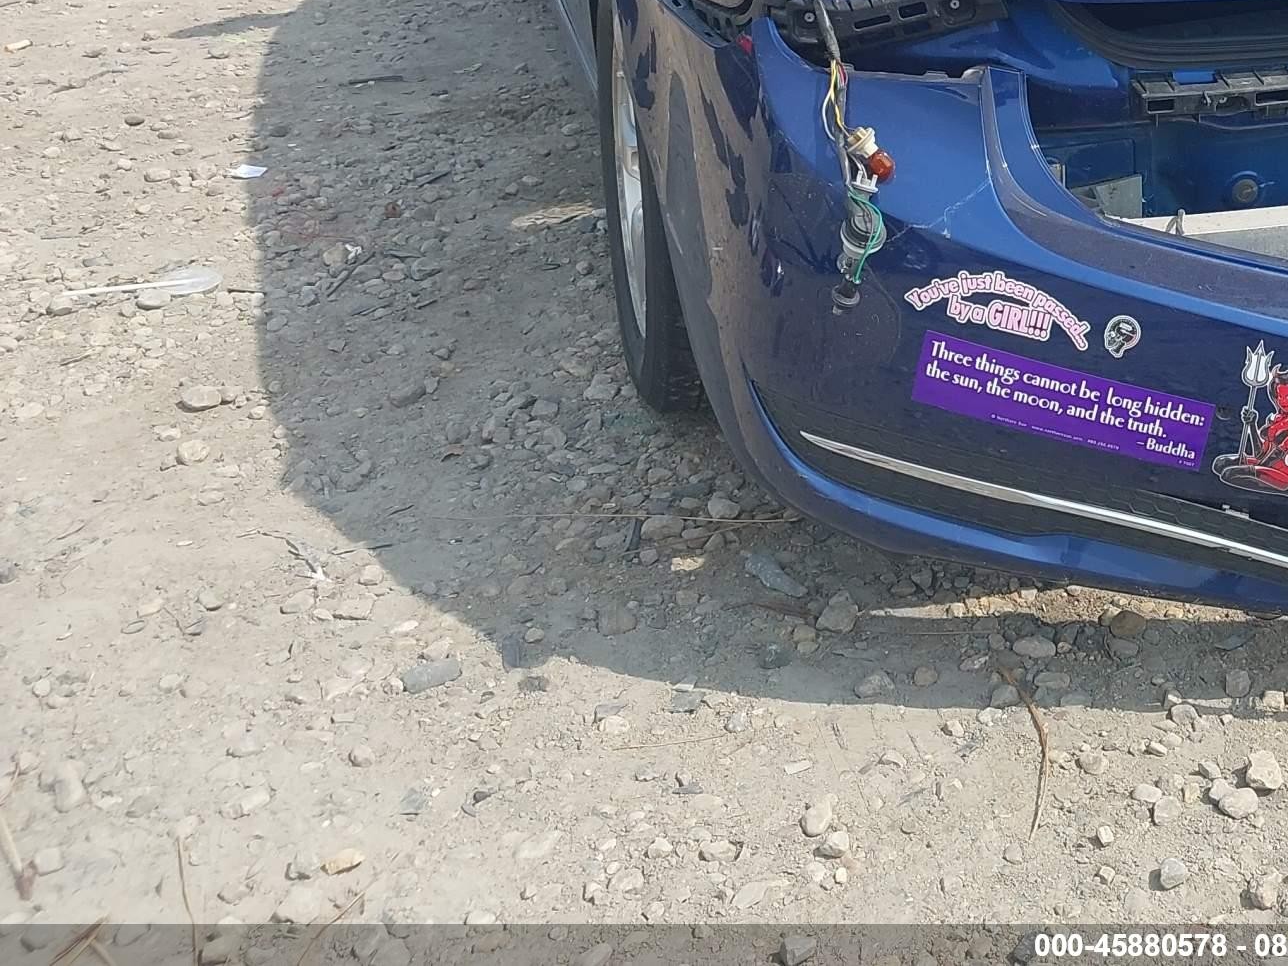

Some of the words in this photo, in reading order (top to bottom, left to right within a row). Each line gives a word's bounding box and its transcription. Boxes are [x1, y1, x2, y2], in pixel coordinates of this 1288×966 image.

[906, 278, 959, 310] You've
[960, 272, 993, 293] just
[995, 272, 1034, 302] been
[949, 297, 973, 323] by
[973, 307, 985, 322] a
[988, 301, 1050, 340] GIRL!!!
[926, 362, 950, 382] the
[952, 375, 982, 395] sun,
[986, 379, 1011, 399] the
[1013, 390, 1063, 415] moon,
[1066, 402, 1098, 425] and
[1100, 407, 1126, 429] the
[1127, 415, 1167, 439] truth.
[931, 340, 973, 367] Three
[974, 351, 1020, 385] things
[1022, 370, 1077, 397] cannot
[1079, 380, 1100, 402] be
[1106, 386, 1142, 418] long
[1144, 397, 1205, 427] hidden:
